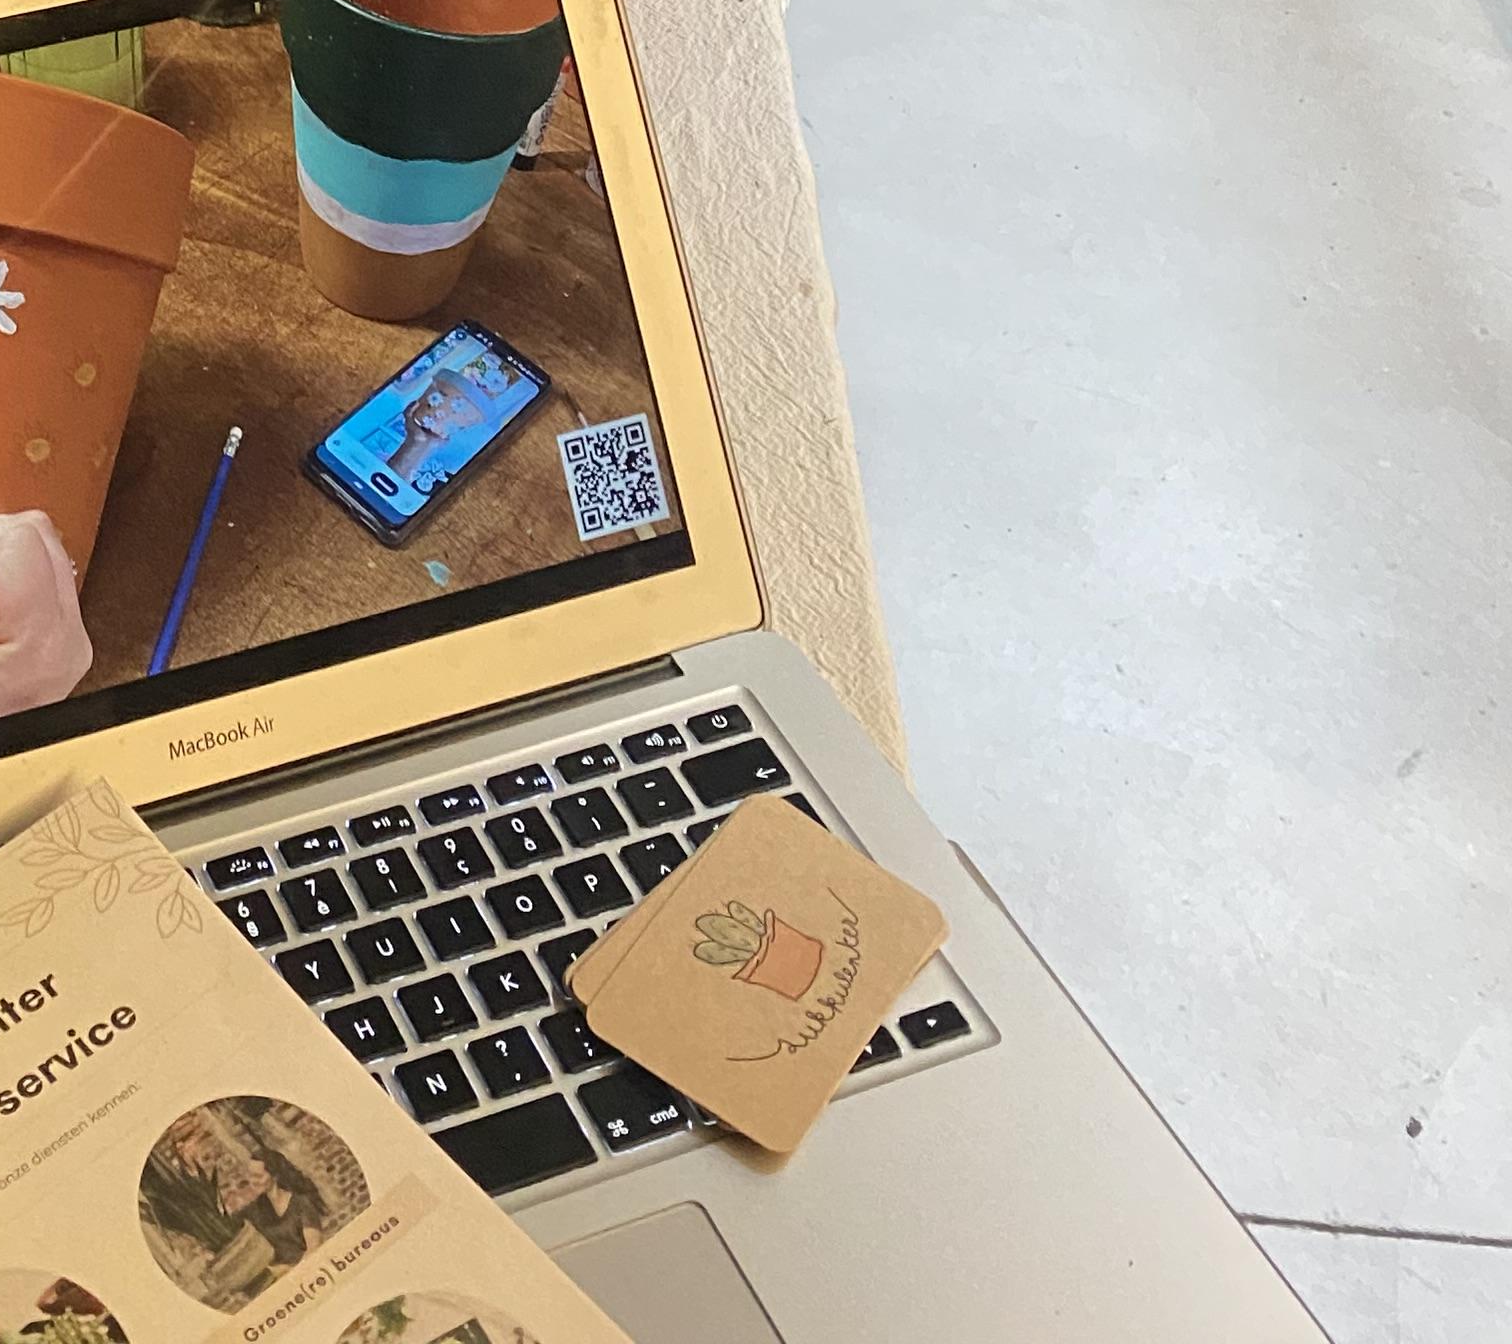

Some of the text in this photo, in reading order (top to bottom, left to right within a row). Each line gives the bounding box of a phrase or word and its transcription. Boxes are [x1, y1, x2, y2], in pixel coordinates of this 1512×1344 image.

[169, 715, 274, 761] MacBook Air
[444, 838, 456, 854] 9
[375, 858, 390, 875] 8
[305, 879, 316, 896] 7
[583, 874, 599, 892] P
[238, 901, 249, 918] 6
[515, 895, 533, 912] O
[375, 938, 394, 956] U
[305, 961, 319, 980] Y
[499, 972, 520, 992] K
[433, 996, 445, 1015] J
[353, 1018, 375, 1040] H
[426, 1073, 448, 1095] N
[650, 1105, 679, 1125] cmd
[31, 1120, 88, 1167] diensten
[244, 1215, 400, 1343] Groene(re) bureaus
